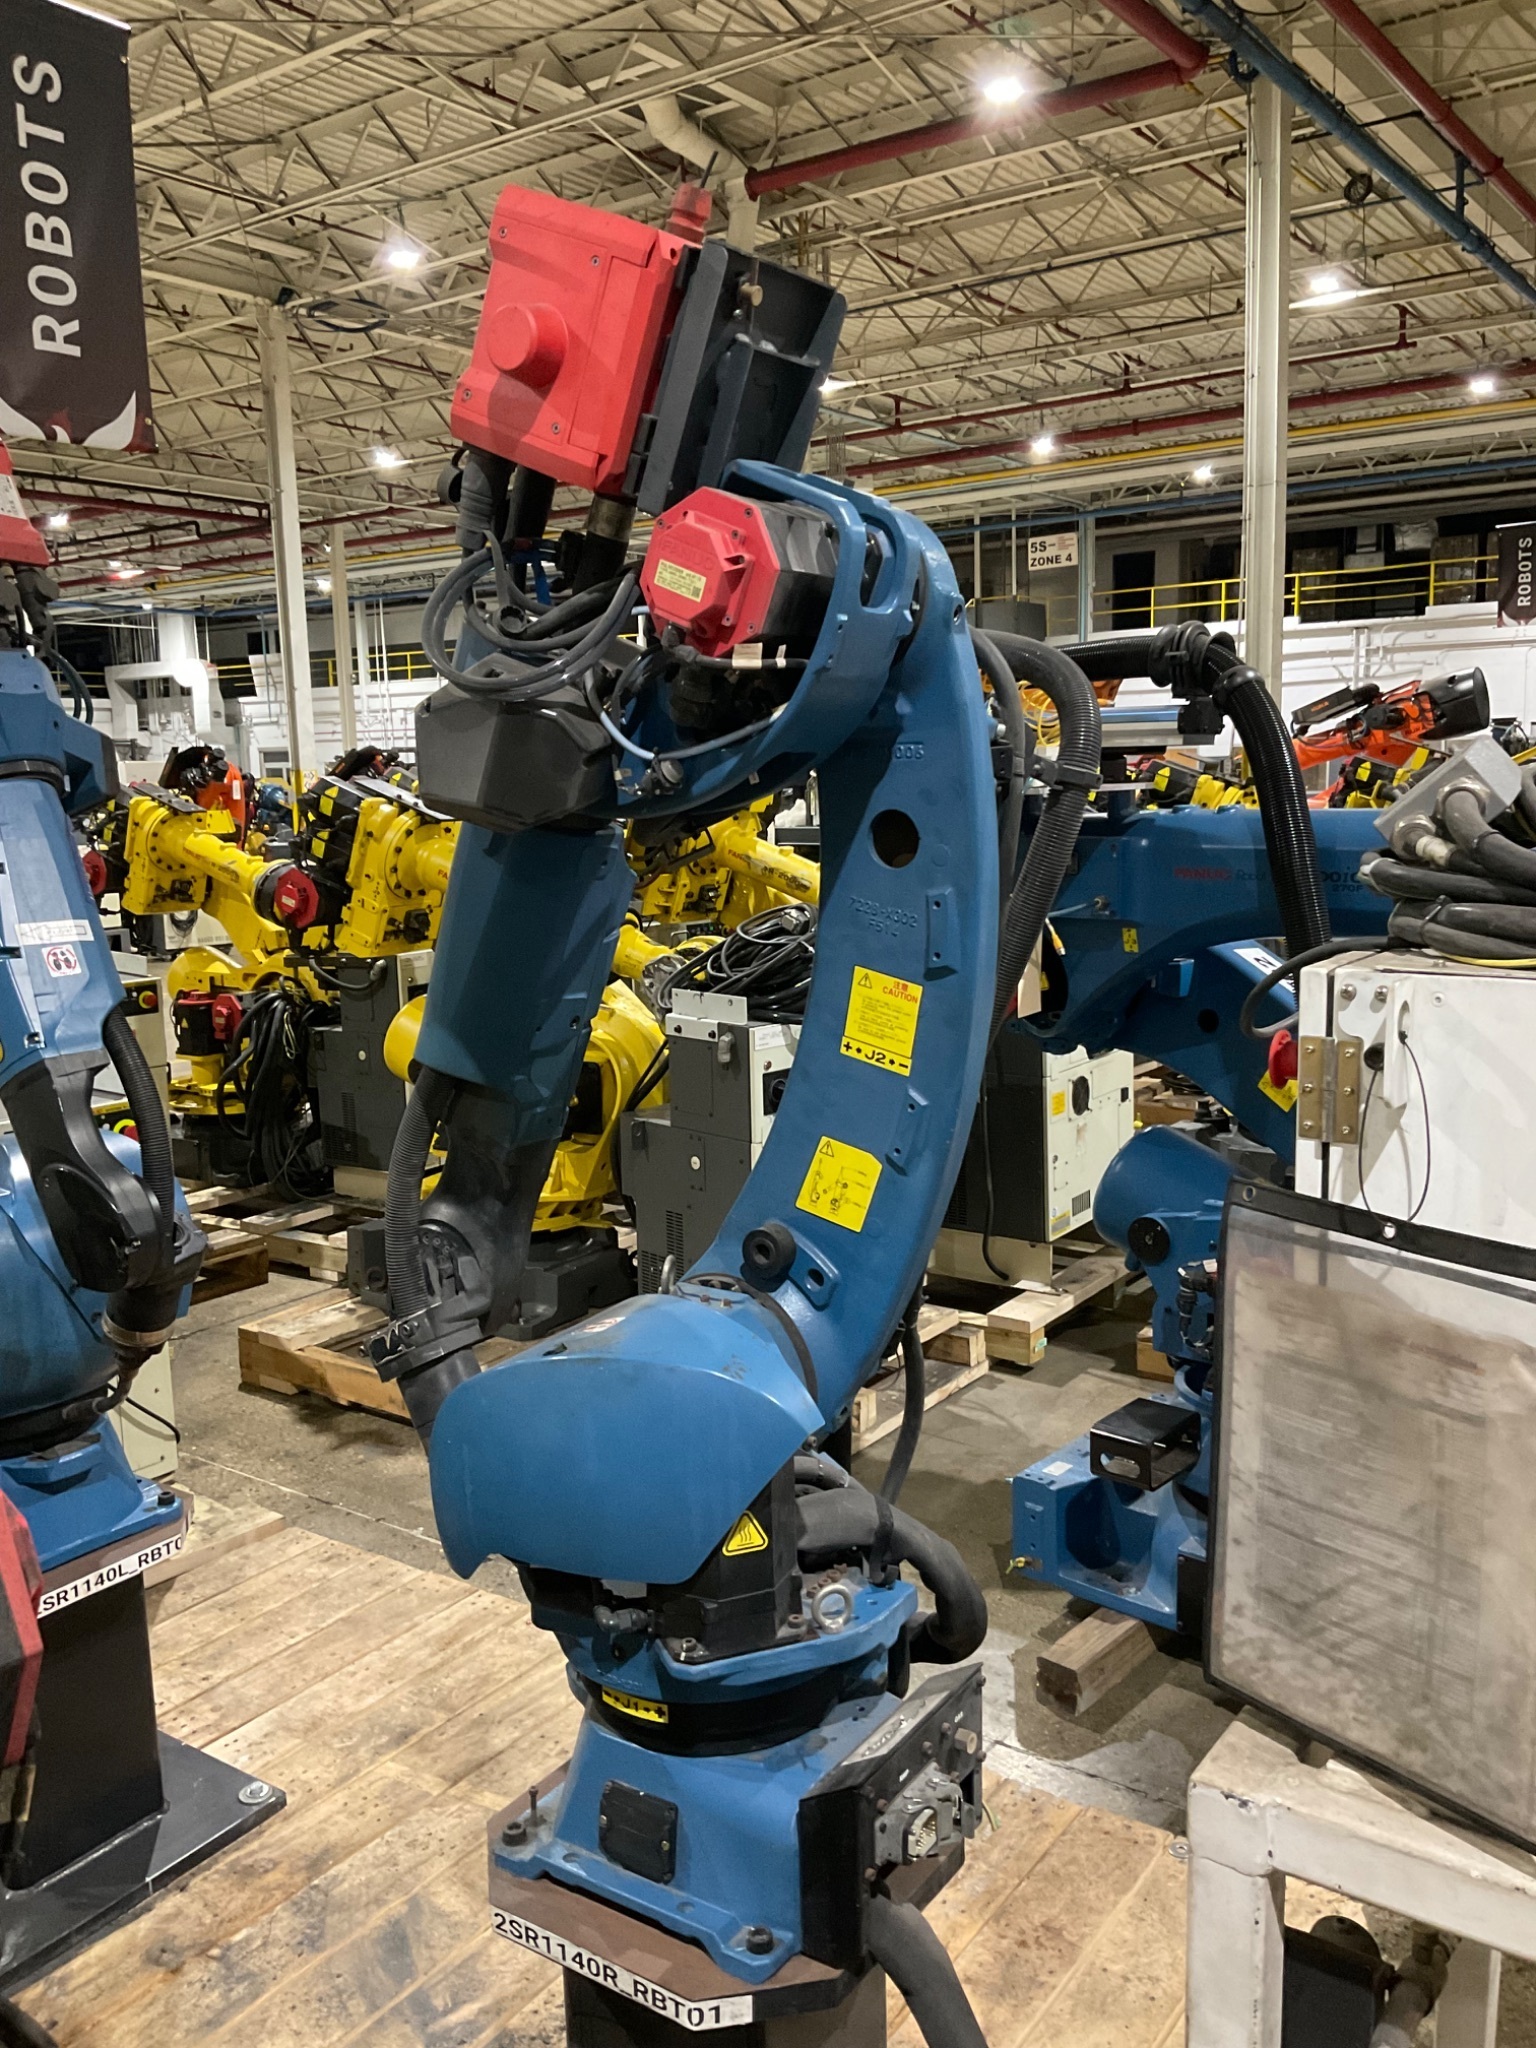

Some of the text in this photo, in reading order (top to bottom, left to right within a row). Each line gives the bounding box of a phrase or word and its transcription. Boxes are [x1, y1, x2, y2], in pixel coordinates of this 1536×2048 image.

[12, 55, 82, 358] ROBOTS
[1030, 552, 1073, 568] ZONE 4
[1517, 537, 1533, 607] ROBOTS
[882, 985, 919, 1004] CAUTION
[864, 1050, 886, 1065] J2
[37, 1537, 182, 1616] SR1140L_RBT0
[622, 1698, 639, 1712] J1
[493, 1912, 721, 2027] 2SR1140R_RBT01
